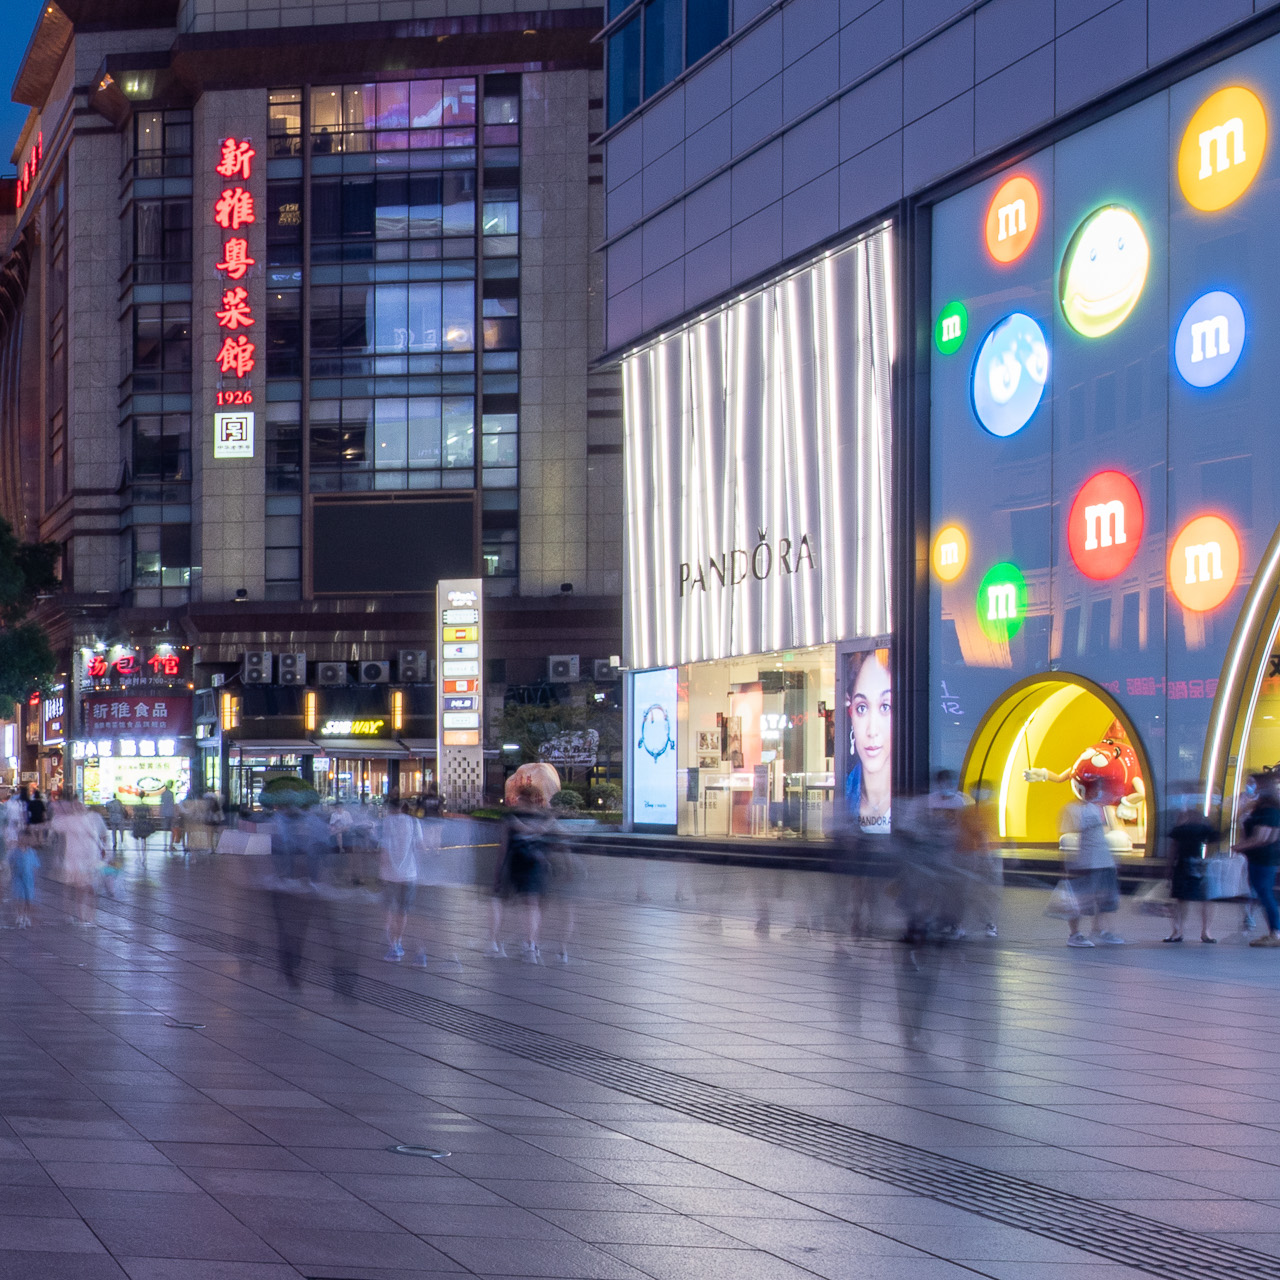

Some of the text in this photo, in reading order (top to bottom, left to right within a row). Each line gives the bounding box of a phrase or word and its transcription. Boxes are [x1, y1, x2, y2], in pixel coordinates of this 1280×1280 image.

[1198, 117, 1246, 180] m
[997, 197, 1027, 242] m
[942, 316, 961, 342] m
[1191, 315, 1230, 363] m
[216, 390, 254, 406] 1926
[1084, 499, 1127, 551] m
[678, 532, 816, 598] PANDORA
[941, 539, 959, 566] m
[1185, 540, 1223, 585] m
[988, 583, 1017, 622] m
[87, 653, 180, 676] 汤包馆
[93, 702, 168, 719] 新雅食品
[450, 699, 471, 708] MLB
[321, 720, 384, 735] SUBWAY
